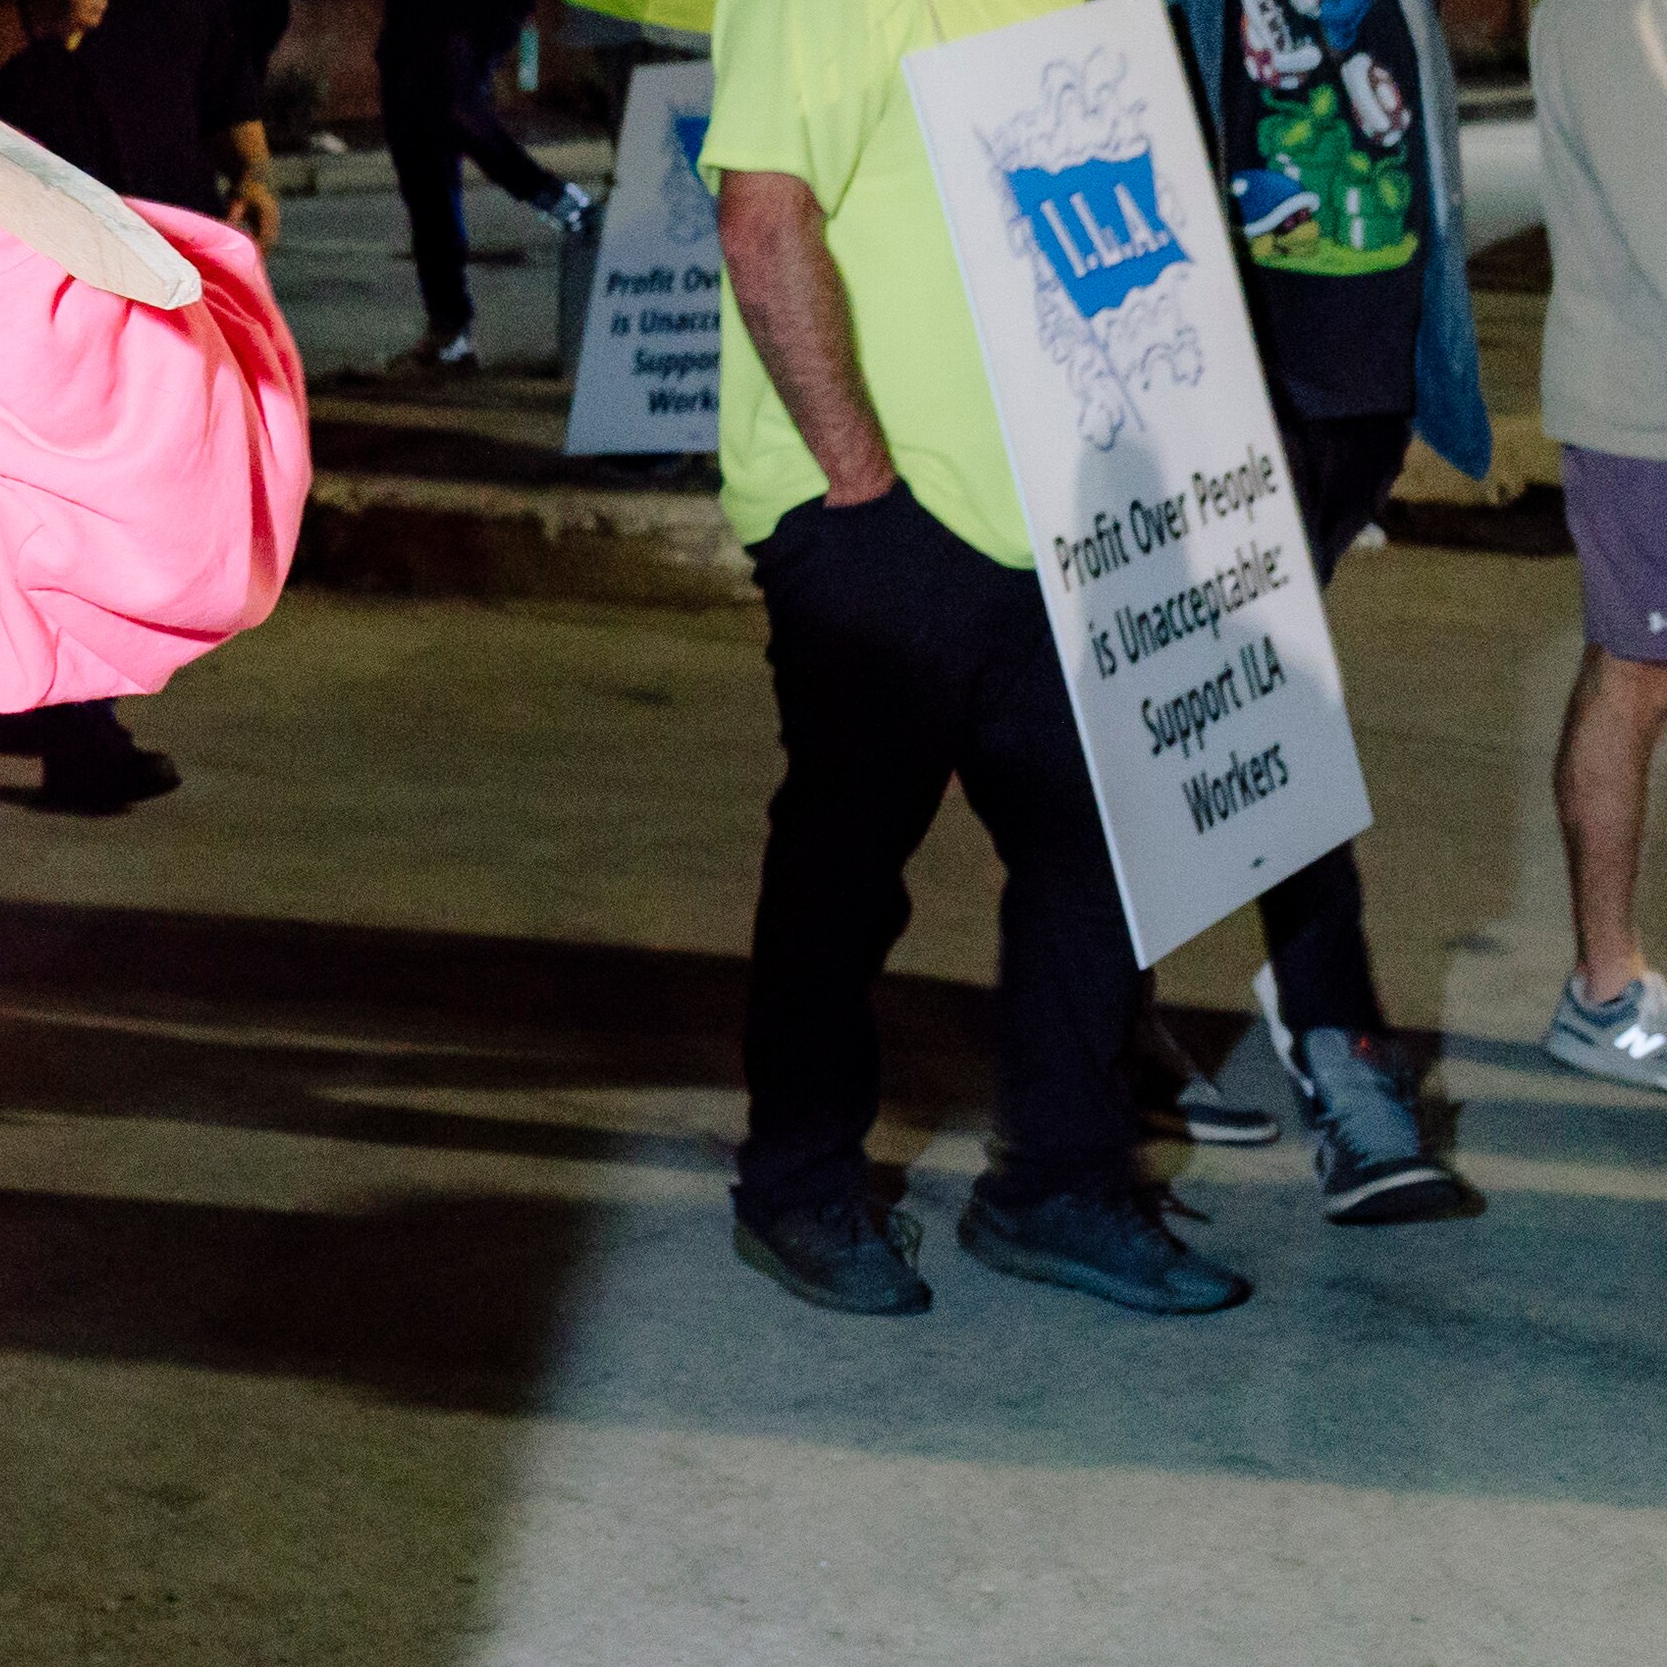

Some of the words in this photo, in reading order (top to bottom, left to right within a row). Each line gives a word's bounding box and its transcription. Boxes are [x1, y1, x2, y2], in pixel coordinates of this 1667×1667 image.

[1040, 183, 1171, 279] I.L.A.
[606, 264, 675, 297] Profit
[633, 349, 721, 382] Suppor
[646, 387, 721, 417] Work
[1054, 509, 1131, 594] Profit
[1129, 490, 1192, 556] Over
[1192, 443, 1278, 524] People
[1089, 620, 1117, 680] is
[1115, 539, 1291, 664] Unacceptable:
[1141, 662, 1244, 760] Support
[1239, 634, 1286, 703] ILA
[1182, 742, 1290, 836] Workers
